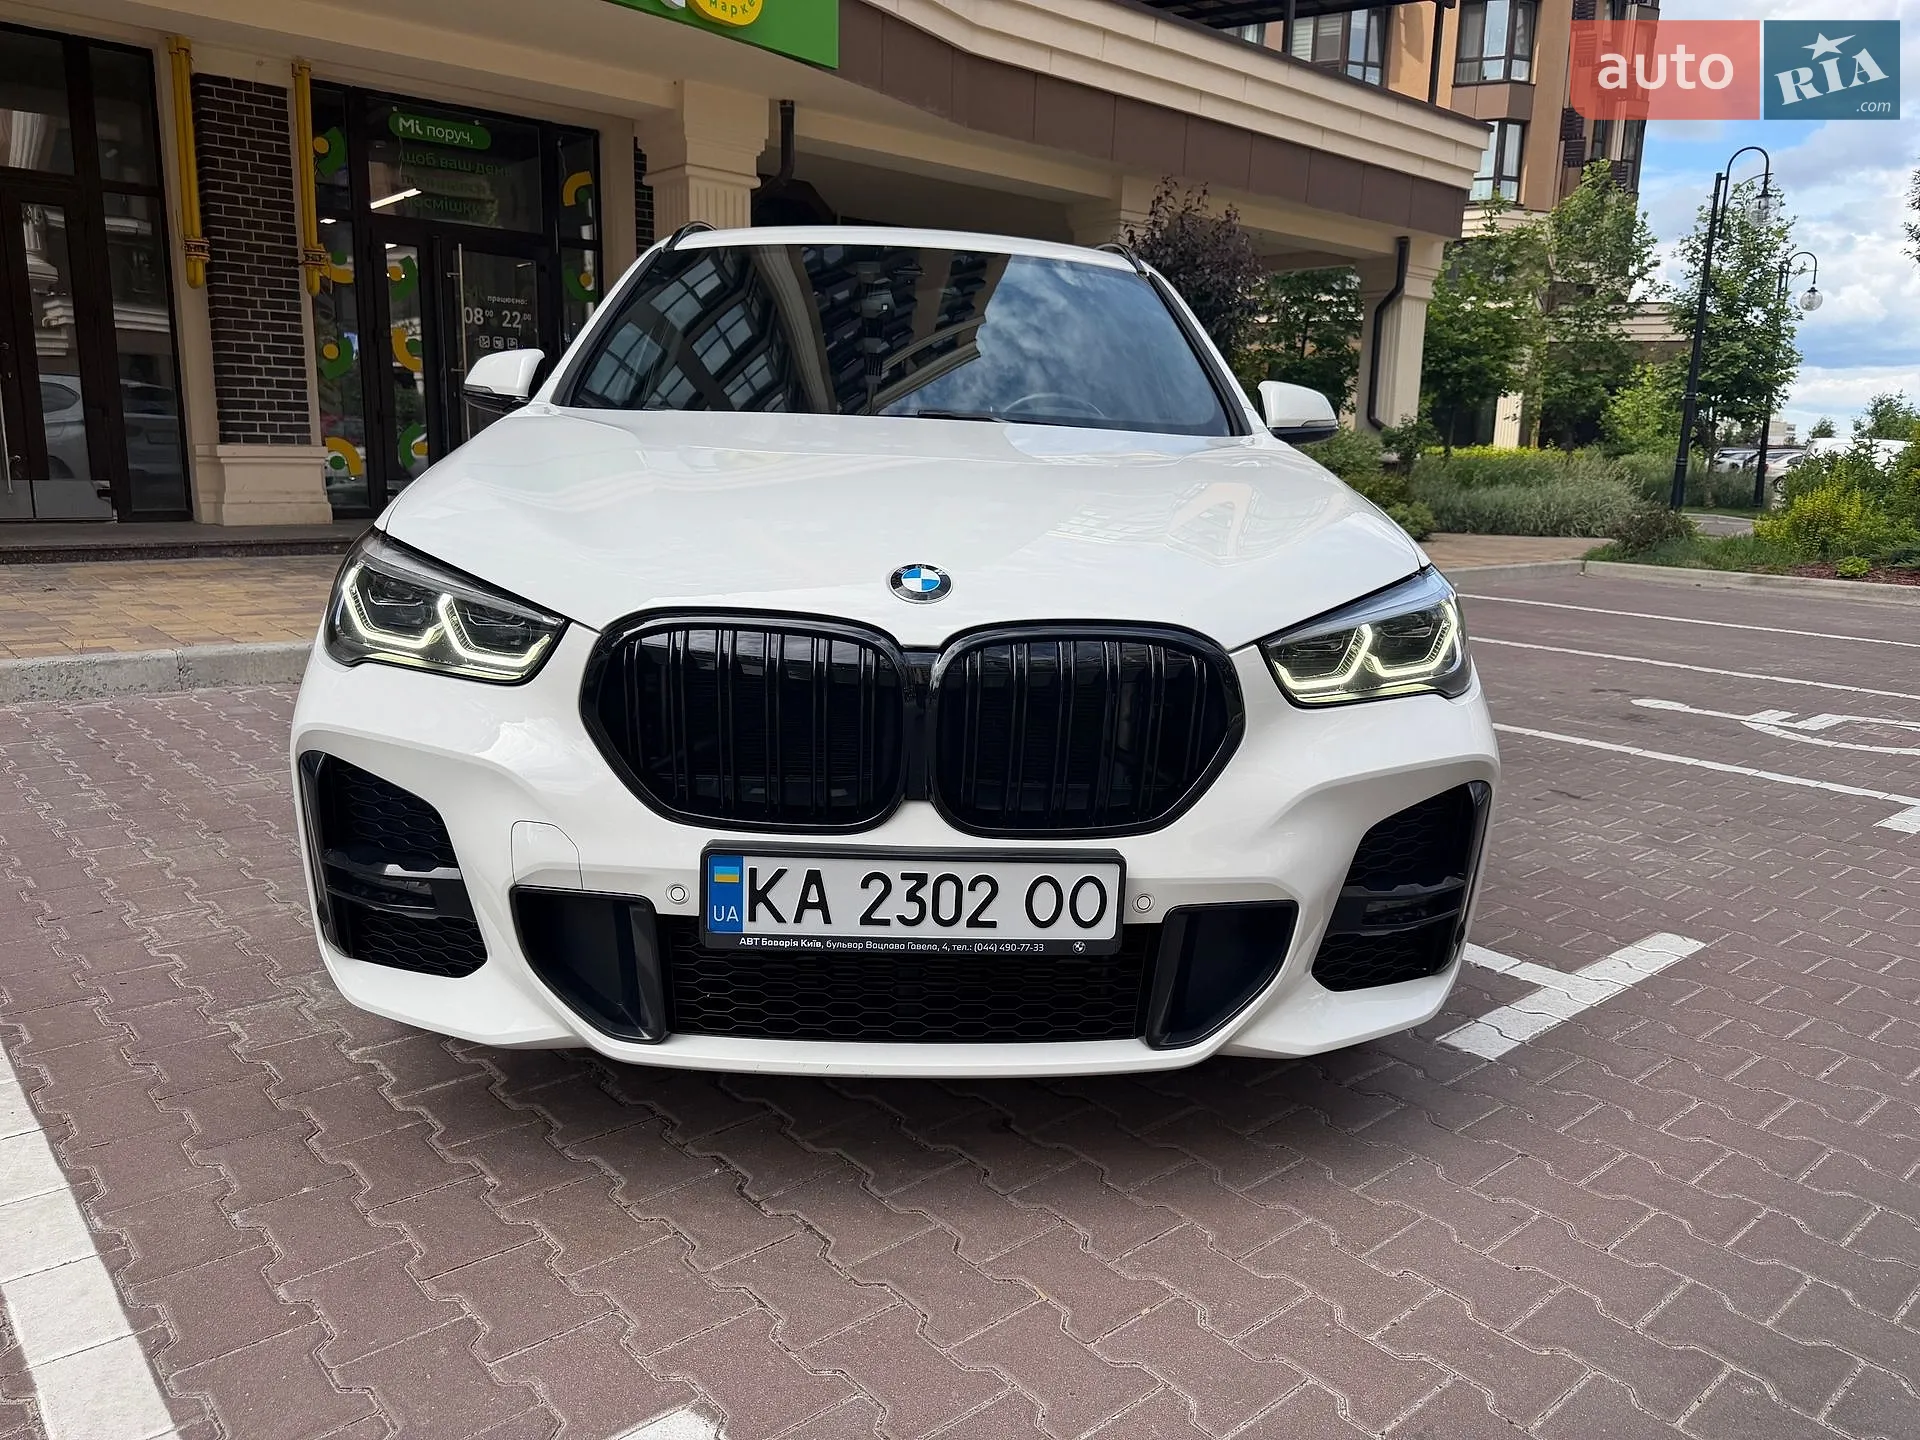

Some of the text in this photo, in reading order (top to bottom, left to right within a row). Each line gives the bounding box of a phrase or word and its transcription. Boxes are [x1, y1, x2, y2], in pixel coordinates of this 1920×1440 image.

[709, 0, 756, 17] марке
[426, 126, 474, 145] поруч,
[440, 158, 471, 173] ваш
[502, 310, 522, 328] 22
[747, 867, 832, 924] KA
[859, 872, 999, 928] 2302
[713, 906, 739, 922] UA
[800, 939, 824, 949] Київ,
[826, 940, 864, 949] бульвар
[942, 942, 950, 952] 4,
[974, 942, 998, 953] (044)
[999, 943, 1044, 952] 490-77-33
